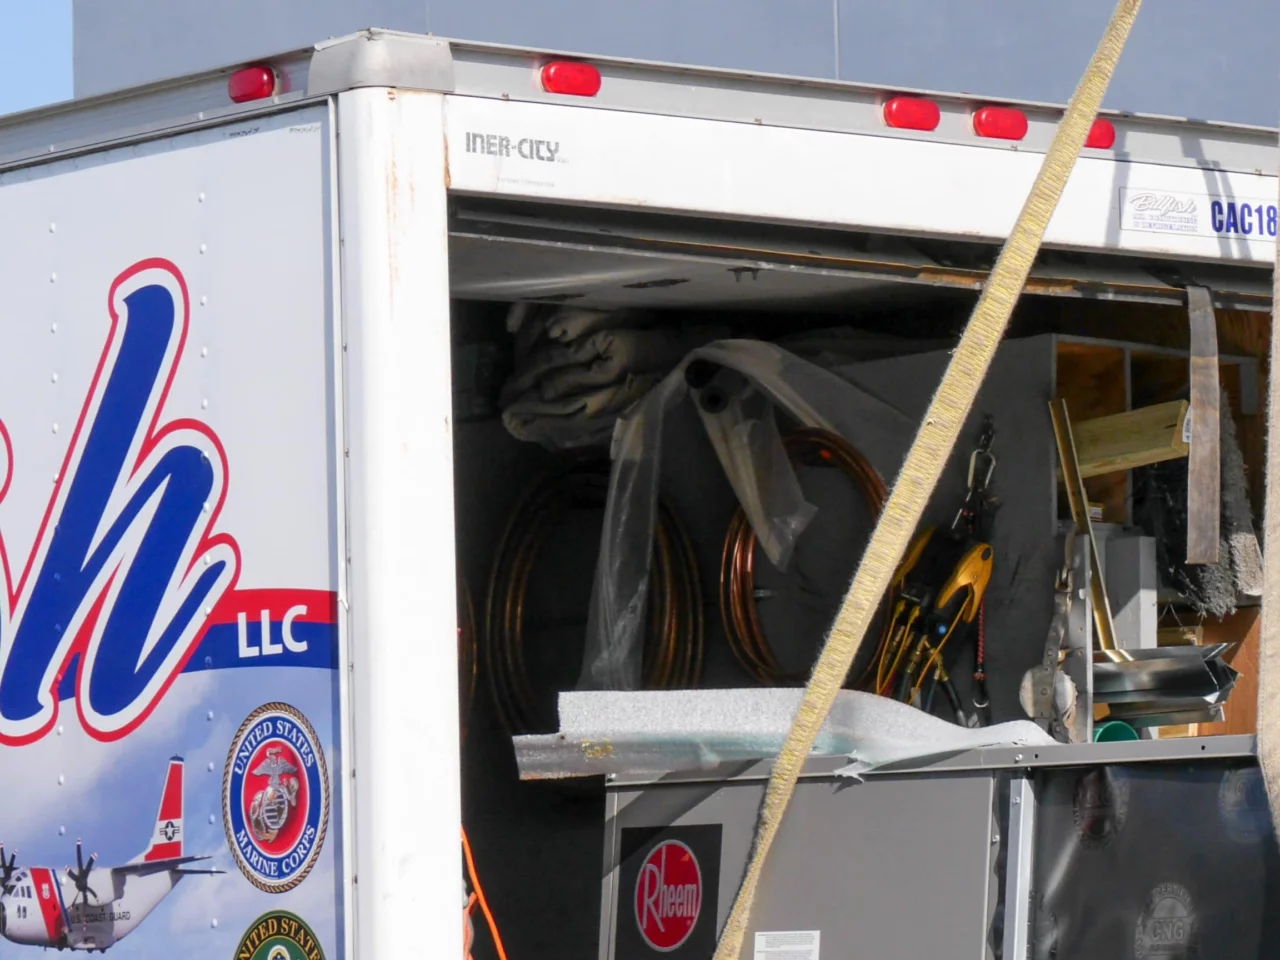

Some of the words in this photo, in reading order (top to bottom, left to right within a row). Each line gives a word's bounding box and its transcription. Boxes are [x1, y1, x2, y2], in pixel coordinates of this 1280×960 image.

[465, 131, 560, 163] INER-CITY
[238, 605, 308, 659] LLC
[234, 721, 273, 776] UNITED
[276, 719, 315, 768] STATES
[237, 828, 279, 877] MARINE
[281, 825, 315, 874] CORPS
[641, 845, 698, 933] Rheem
[1151, 919, 1185, 941] CNG
